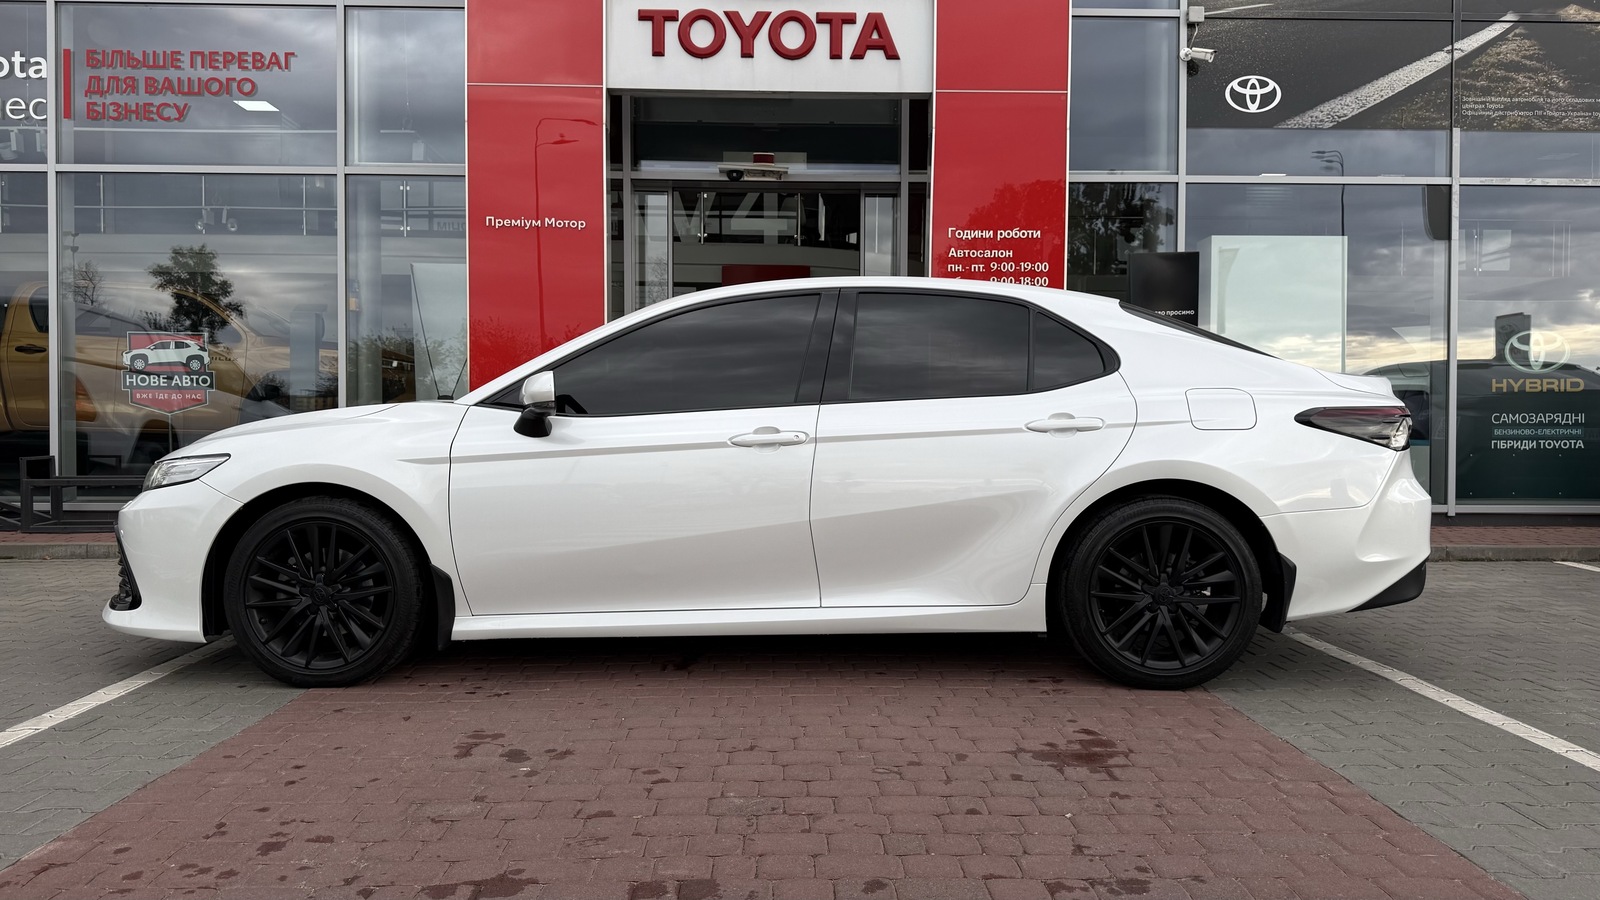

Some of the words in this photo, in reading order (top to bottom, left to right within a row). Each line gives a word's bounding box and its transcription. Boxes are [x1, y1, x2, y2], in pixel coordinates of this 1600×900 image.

[638, 9, 900, 60] TOYOTA
[85, 49, 182, 69] БІЛЬШЕ
[189, 51, 296, 70] ПЕРЕВАГ
[84, 75, 137, 98] ДЛЯ
[144, 76, 256, 97] ВАШОГО
[86, 101, 189, 121] БІЗНЕСУ
[485, 216, 541, 230] Преміум
[544, 217, 586, 230] Мотор
[948, 228, 993, 240] Години
[997, 228, 1041, 241] роботи
[948, 248, 1013, 258] Автосалон
[990, 262, 1049, 272] 9:00-19:00
[126, 374, 168, 386] НОВЕ
[171, 374, 211, 387] АВТО
[1491, 378, 1585, 393] HYBRID
[155, 391, 169, 400] ЇДЕ
[1491, 413, 1585, 425] САМОЗАРЯДНІ
[1494, 428, 1582, 436] БЕНЗИНОВО-ЕЛЕКТРИЧНІ
[1491, 440, 1537, 450] ГІБРИДИ
[1539, 440, 1585, 449] TOYOTA
